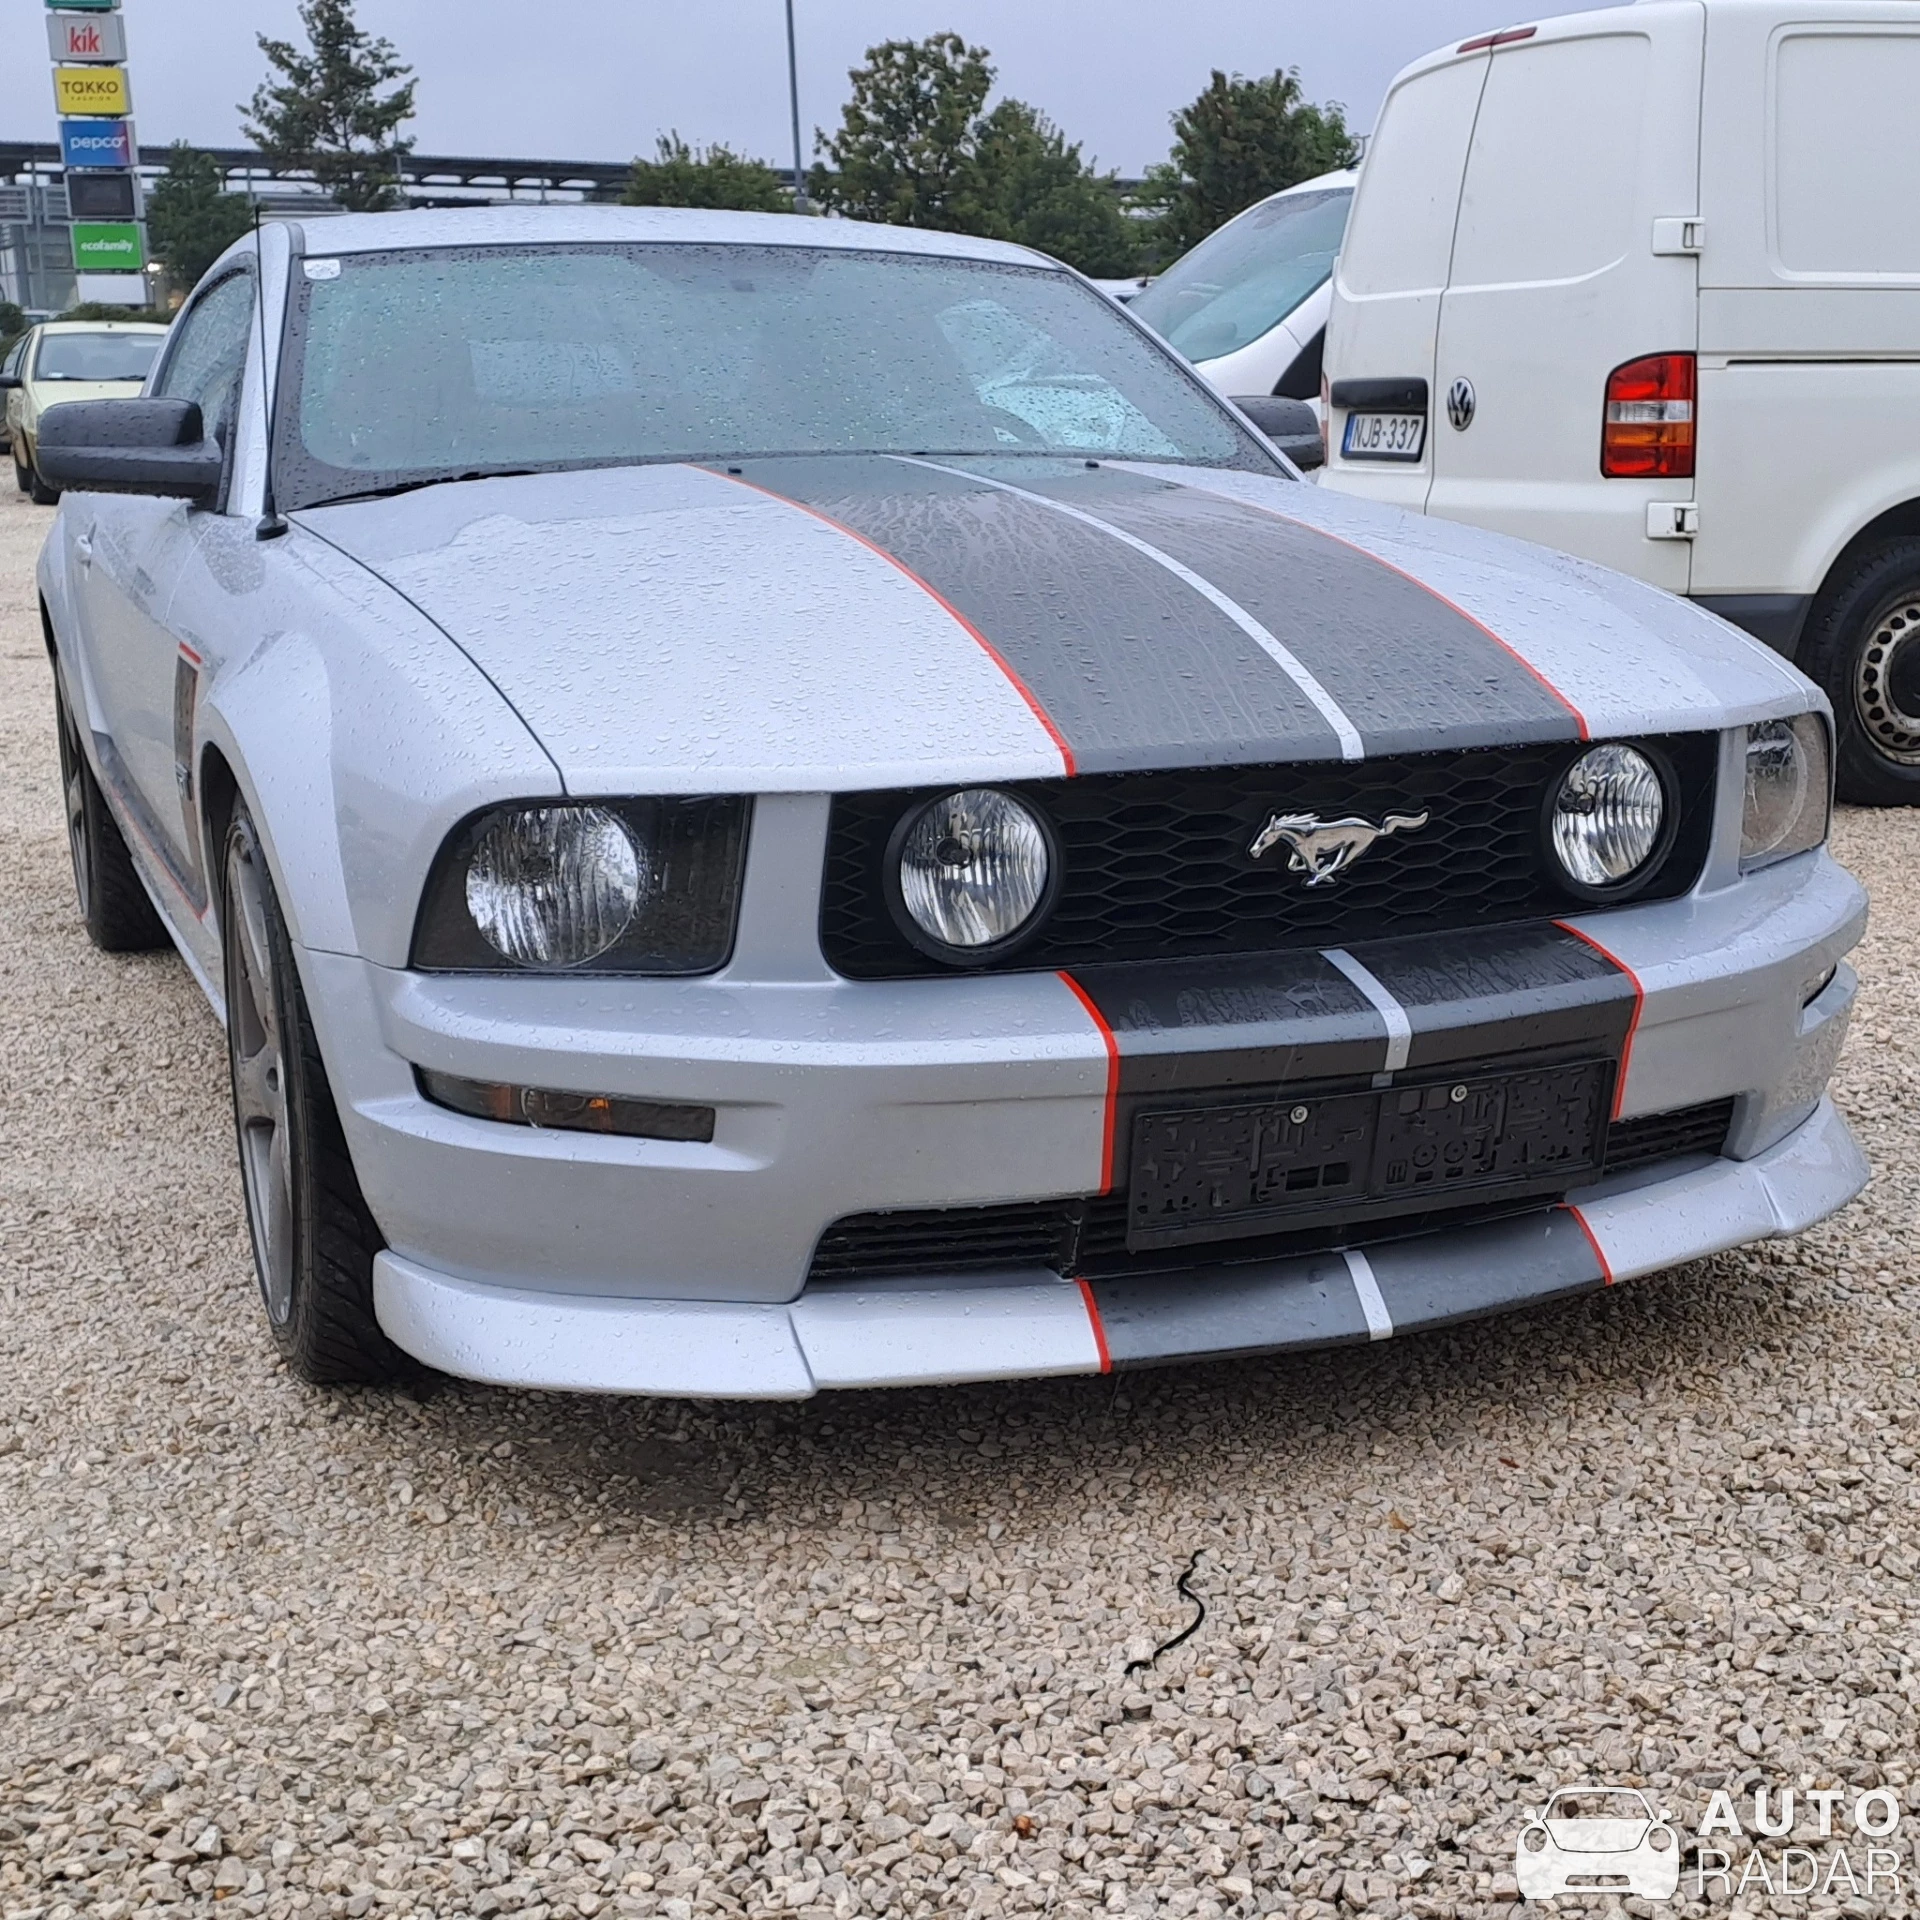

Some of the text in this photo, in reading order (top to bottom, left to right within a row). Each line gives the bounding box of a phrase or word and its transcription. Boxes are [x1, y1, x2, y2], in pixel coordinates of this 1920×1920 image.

[70, 136, 126, 150] pepco
[80, 239, 133, 253] ecofamily
[1352, 418, 1420, 450] NJB-337
